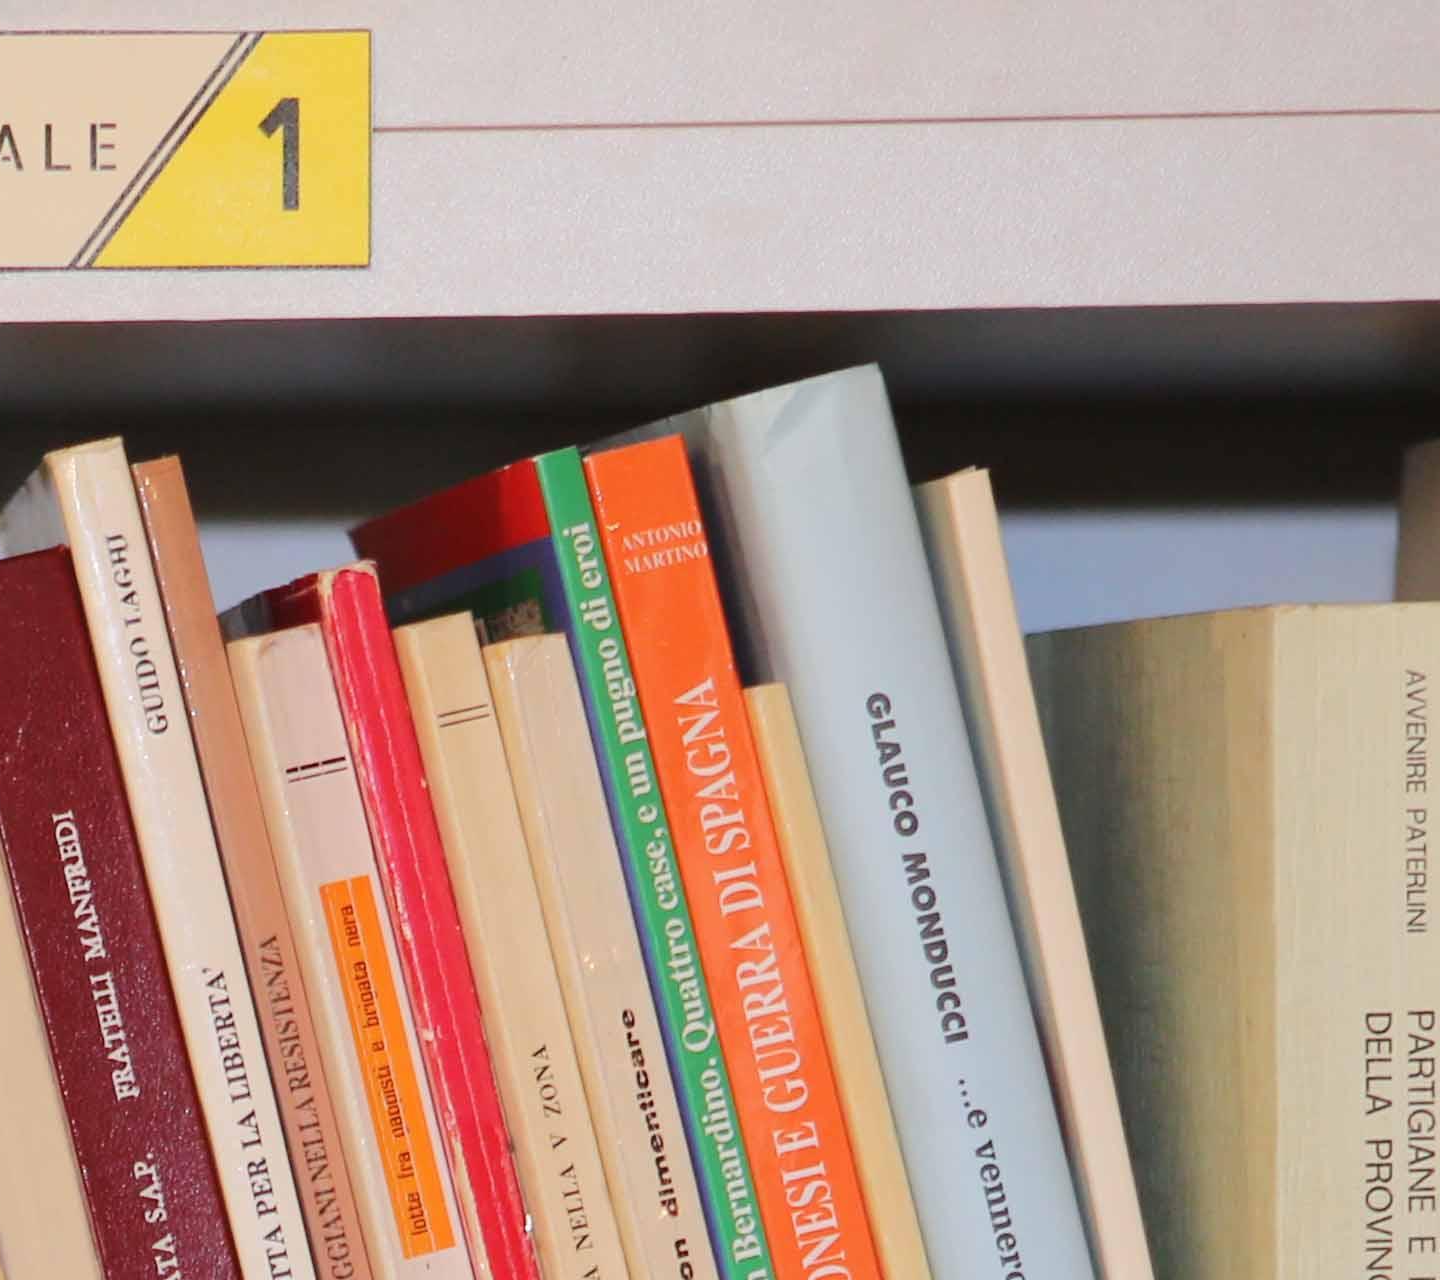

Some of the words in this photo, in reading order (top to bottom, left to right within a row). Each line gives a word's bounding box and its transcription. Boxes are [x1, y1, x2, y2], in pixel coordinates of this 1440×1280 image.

[257, 96, 301, 212] 1
[563, 522, 602, 590] eroi
[576, 597, 615, 629] di
[602, 638, 652, 744] pugno
[1403, 669, 1427, 793] AVVENIRE
[628, 752, 653, 795] un
[52, 810, 111, 962] MANFREDI
[650, 832, 688, 911] case,
[866, 692, 919, 839] GLAUCO
[904, 849, 970, 1046] MONDUCCI
[1405, 807, 1429, 935] PATERLINI
[90, 970, 142, 1100] FRATELLI
[670, 918, 715, 1051] Quattro
[1362, 1011, 1395, 1117] DELLA
[137, 1152, 176, 1223] S.A.P.
[690, 1056, 770, 1263] Bernardino.
[1408, 1235, 1436, 1255] E
